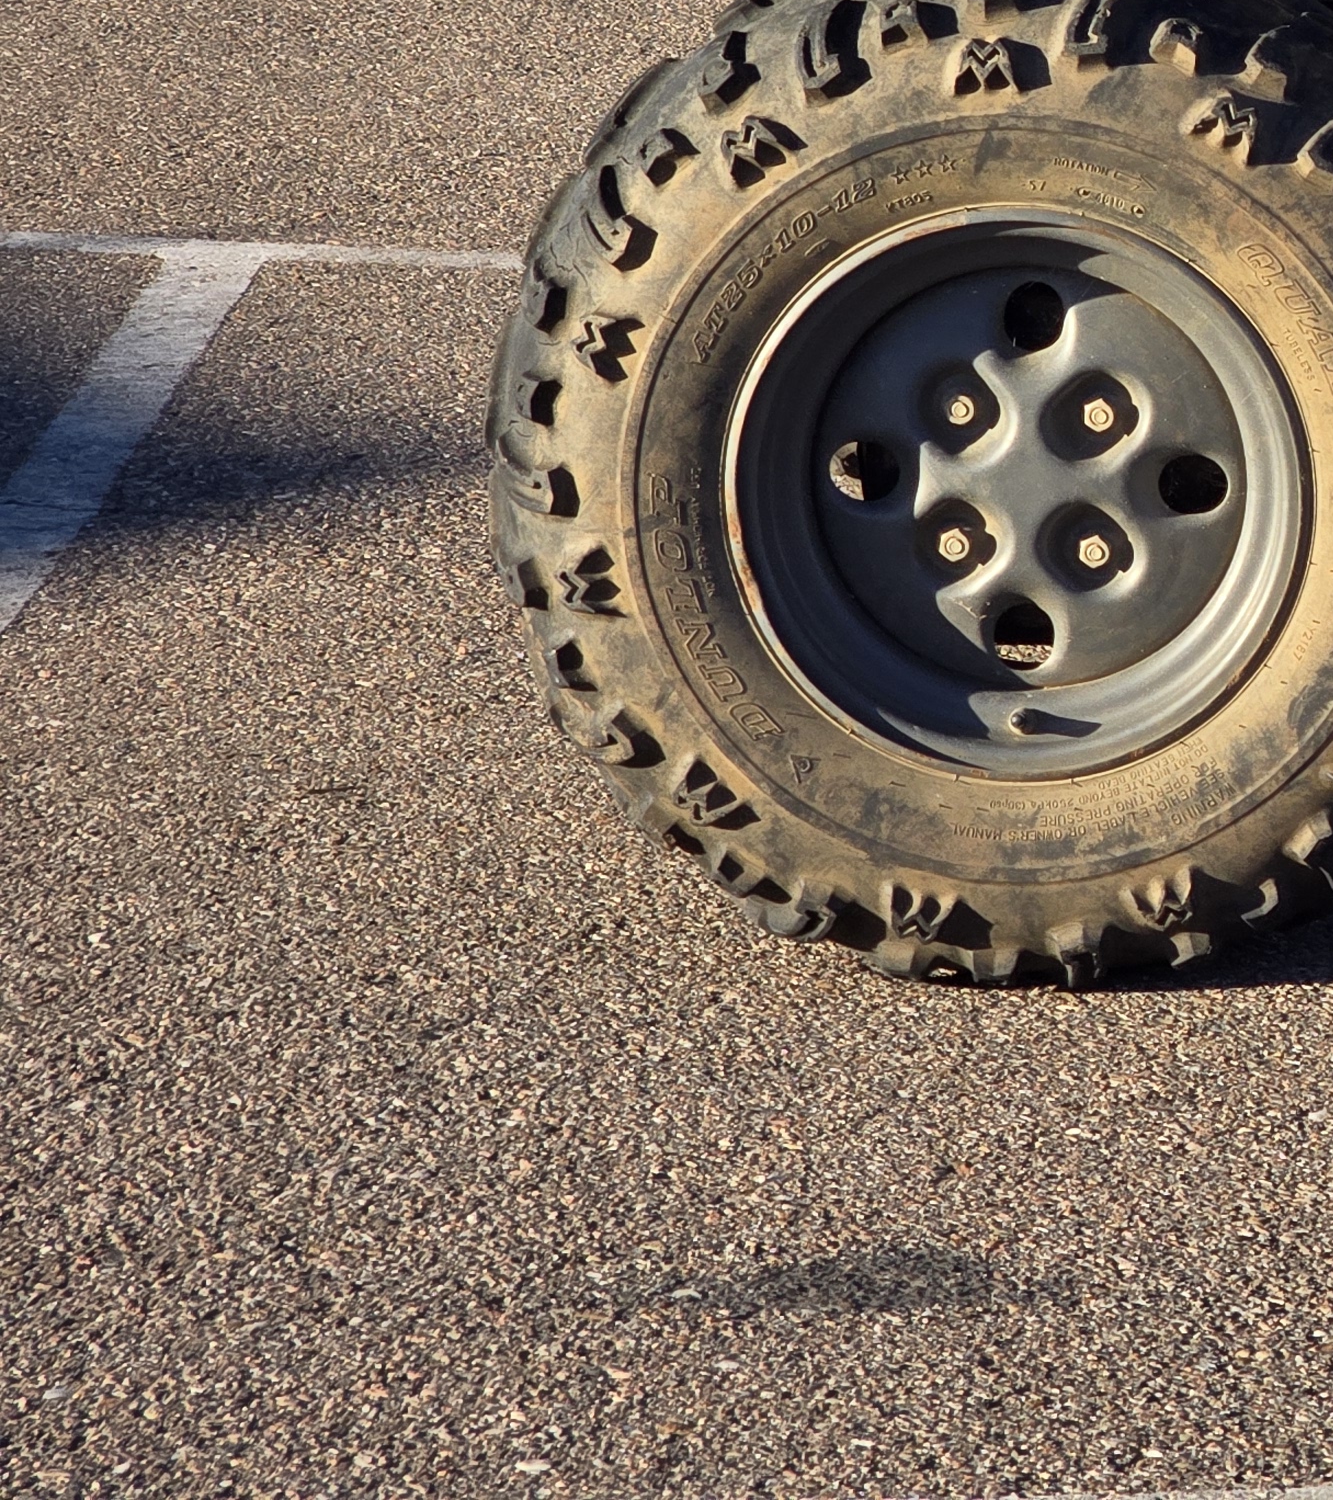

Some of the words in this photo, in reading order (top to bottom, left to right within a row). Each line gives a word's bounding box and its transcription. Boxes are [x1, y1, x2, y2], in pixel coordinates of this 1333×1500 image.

[1281, 326, 1317, 382] TUBELESS
[649, 472, 787, 744] DUNLOP
[1112, 770, 1192, 815] OPERATING
[1138, 781, 1199, 820] VEHICLE
[1170, 781, 1237, 827] WARNING
[1037, 802, 1113, 828] PRESSURE
[1066, 822, 1088, 839] OR
[1089, 808, 1138, 834] LABEL
